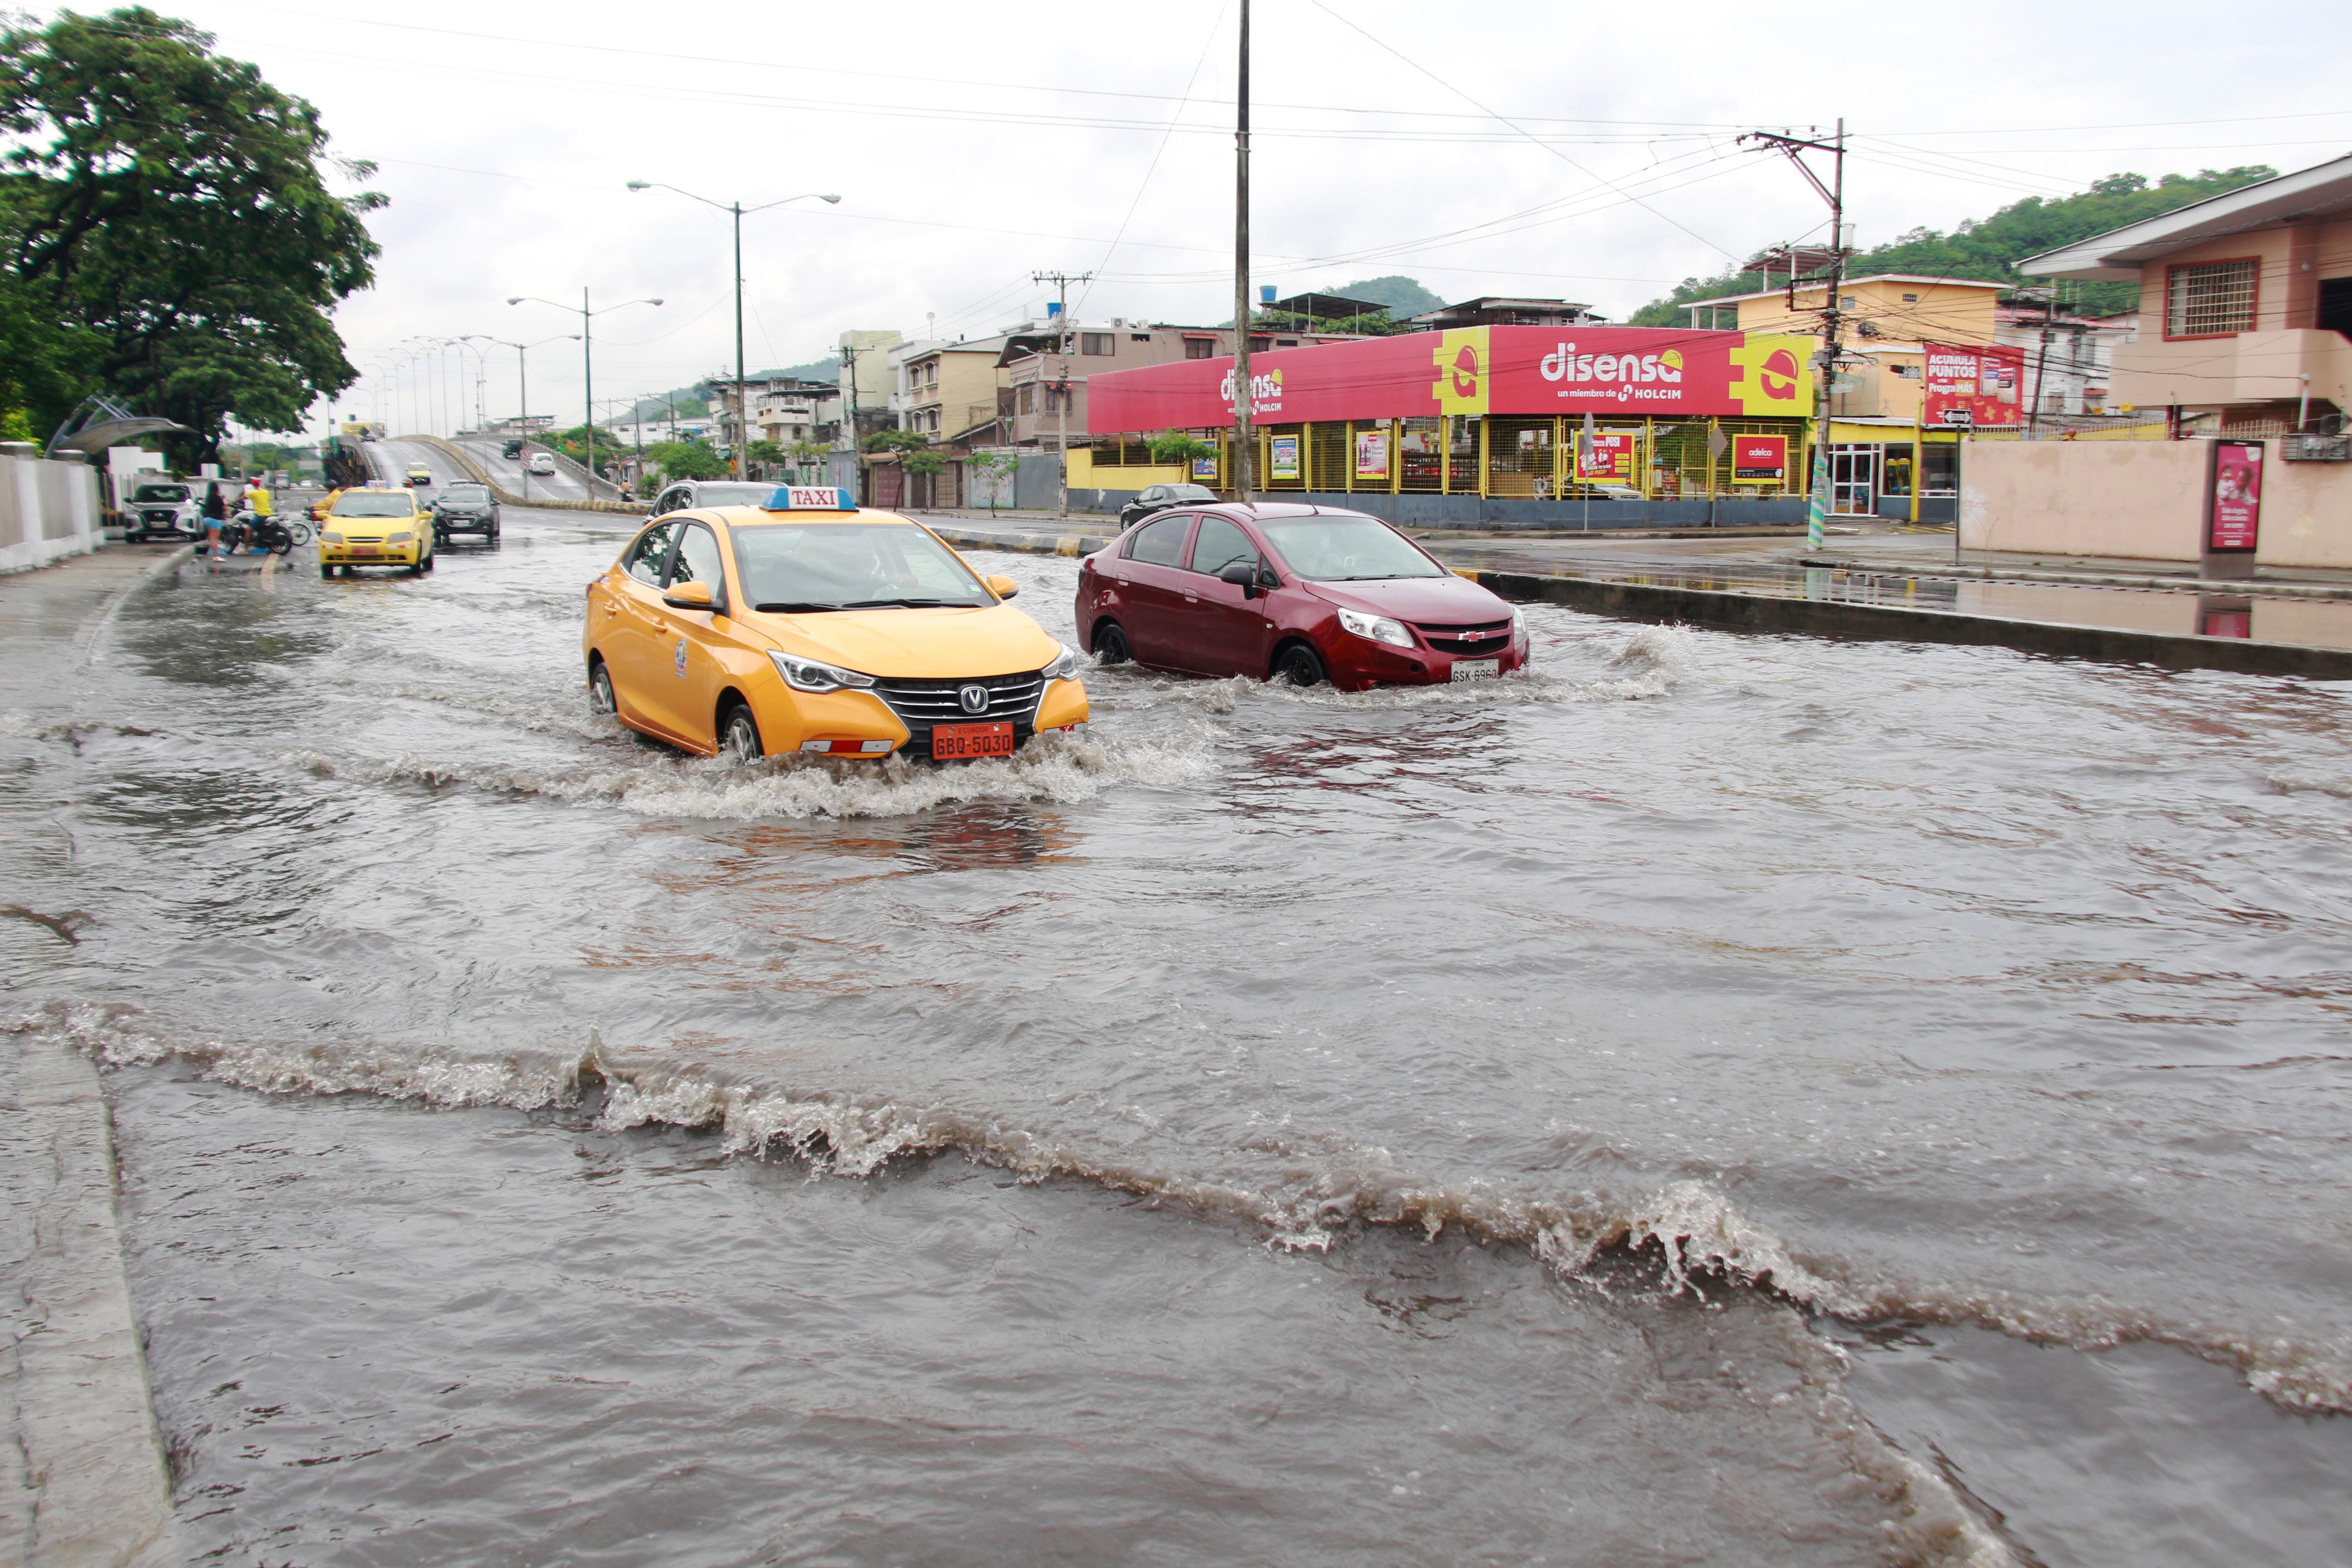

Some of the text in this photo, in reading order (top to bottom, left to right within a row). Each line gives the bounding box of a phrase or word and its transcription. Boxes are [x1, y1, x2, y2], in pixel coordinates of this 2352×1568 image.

[1540, 343, 1682, 382] disensa
[1929, 355, 1976, 365] ACUMULA
[1928, 365, 1976, 378] PUNTOS
[1569, 389, 1605, 397] miembro
[1606, 389, 1616, 397] de
[1635, 389, 1681, 399] HOLCIM
[1259, 402, 1281, 412] HOLCIM
[1749, 448, 1772, 456] adelca
[791, 490, 835, 505] TAXI
[936, 735, 1010, 755] GBQ-5030
